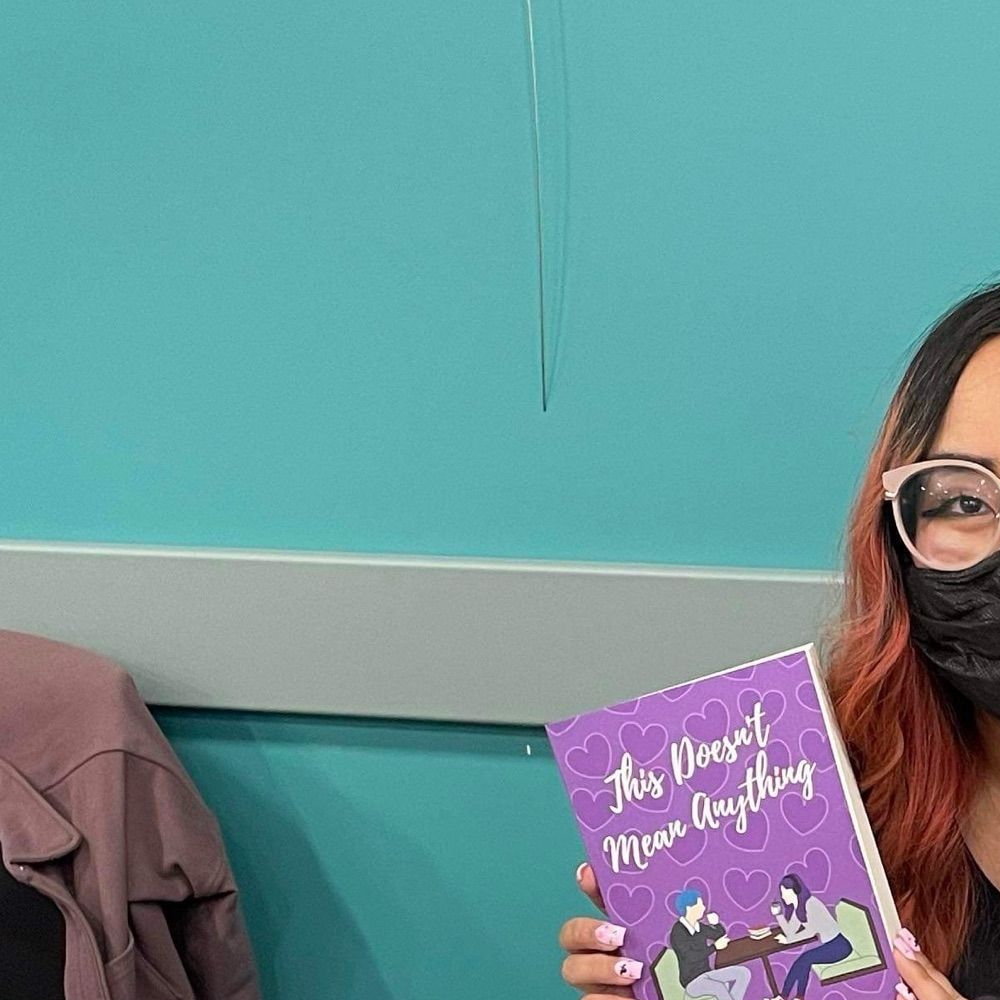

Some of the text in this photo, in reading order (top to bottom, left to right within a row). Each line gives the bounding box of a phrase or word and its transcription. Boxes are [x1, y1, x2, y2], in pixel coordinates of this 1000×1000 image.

[603, 750, 816, 873] Mean Anything
[604, 702, 770, 814] This Doesn't
